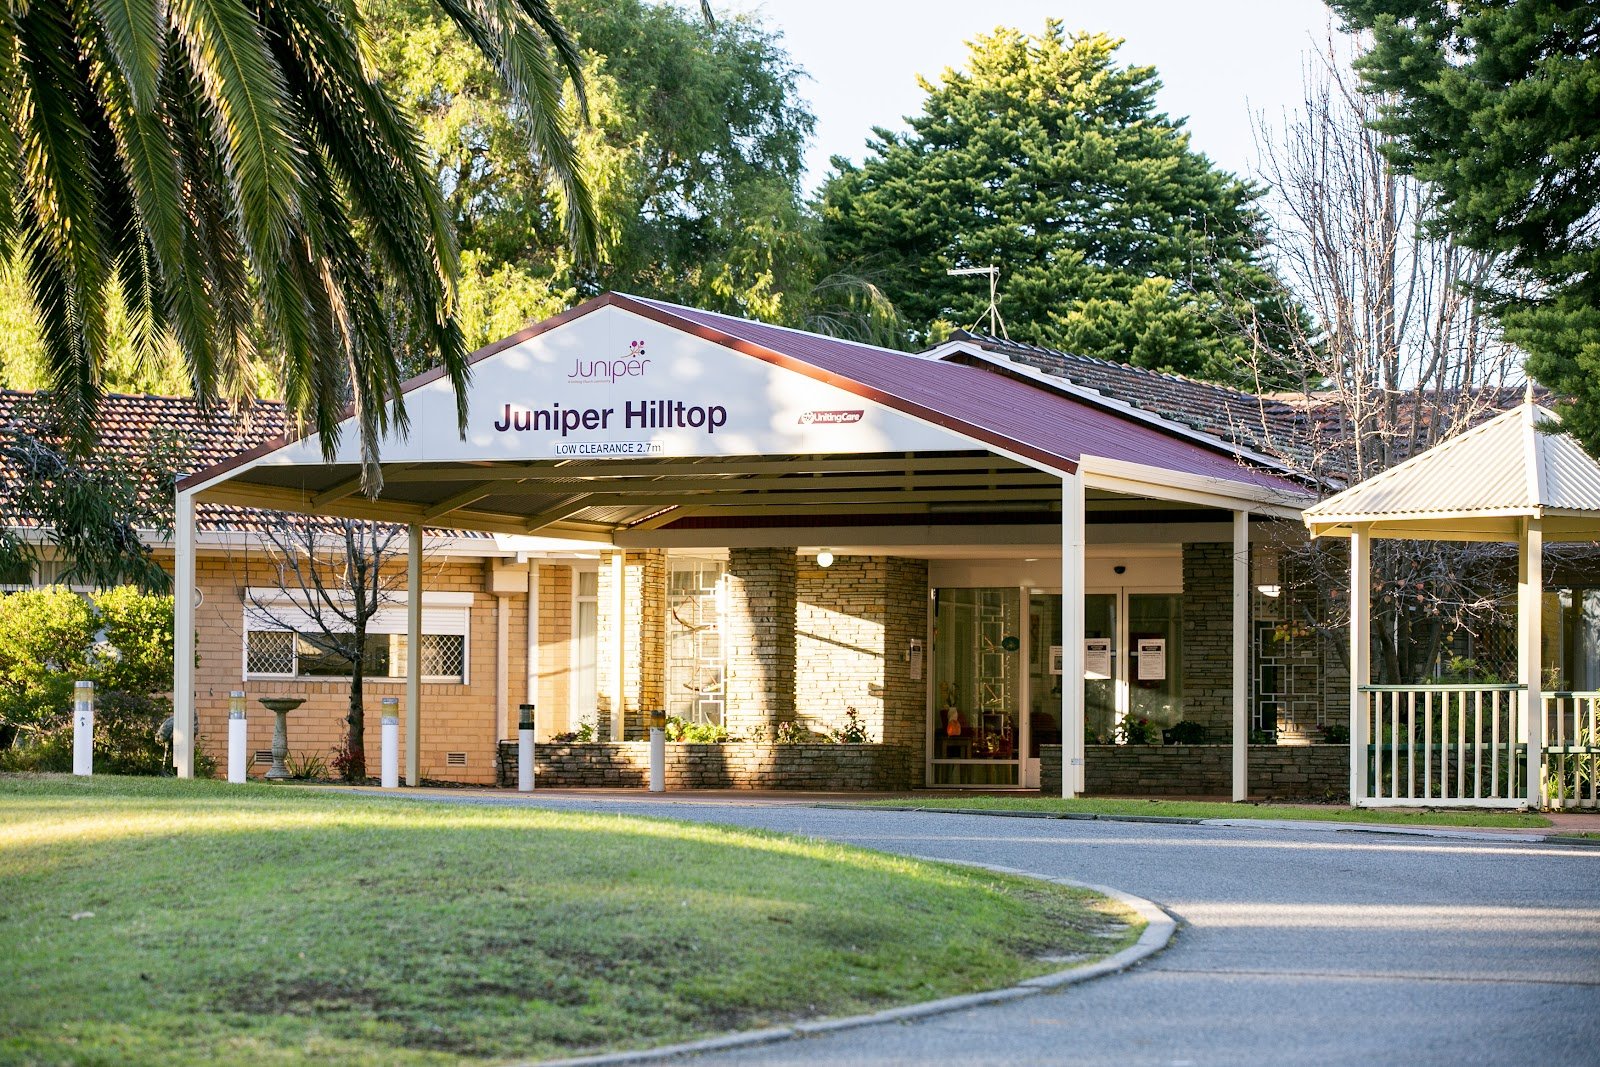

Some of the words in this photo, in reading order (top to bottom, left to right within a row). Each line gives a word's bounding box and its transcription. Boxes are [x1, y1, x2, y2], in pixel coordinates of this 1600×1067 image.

[568, 358, 651, 384] Juniper
[494, 403, 614, 437] Juniper
[625, 400, 727, 433] Hilltop
[556, 444, 577, 455] LOW
[579, 443, 634, 454] CLEARANCE
[636, 442, 661, 453] 2.7m
